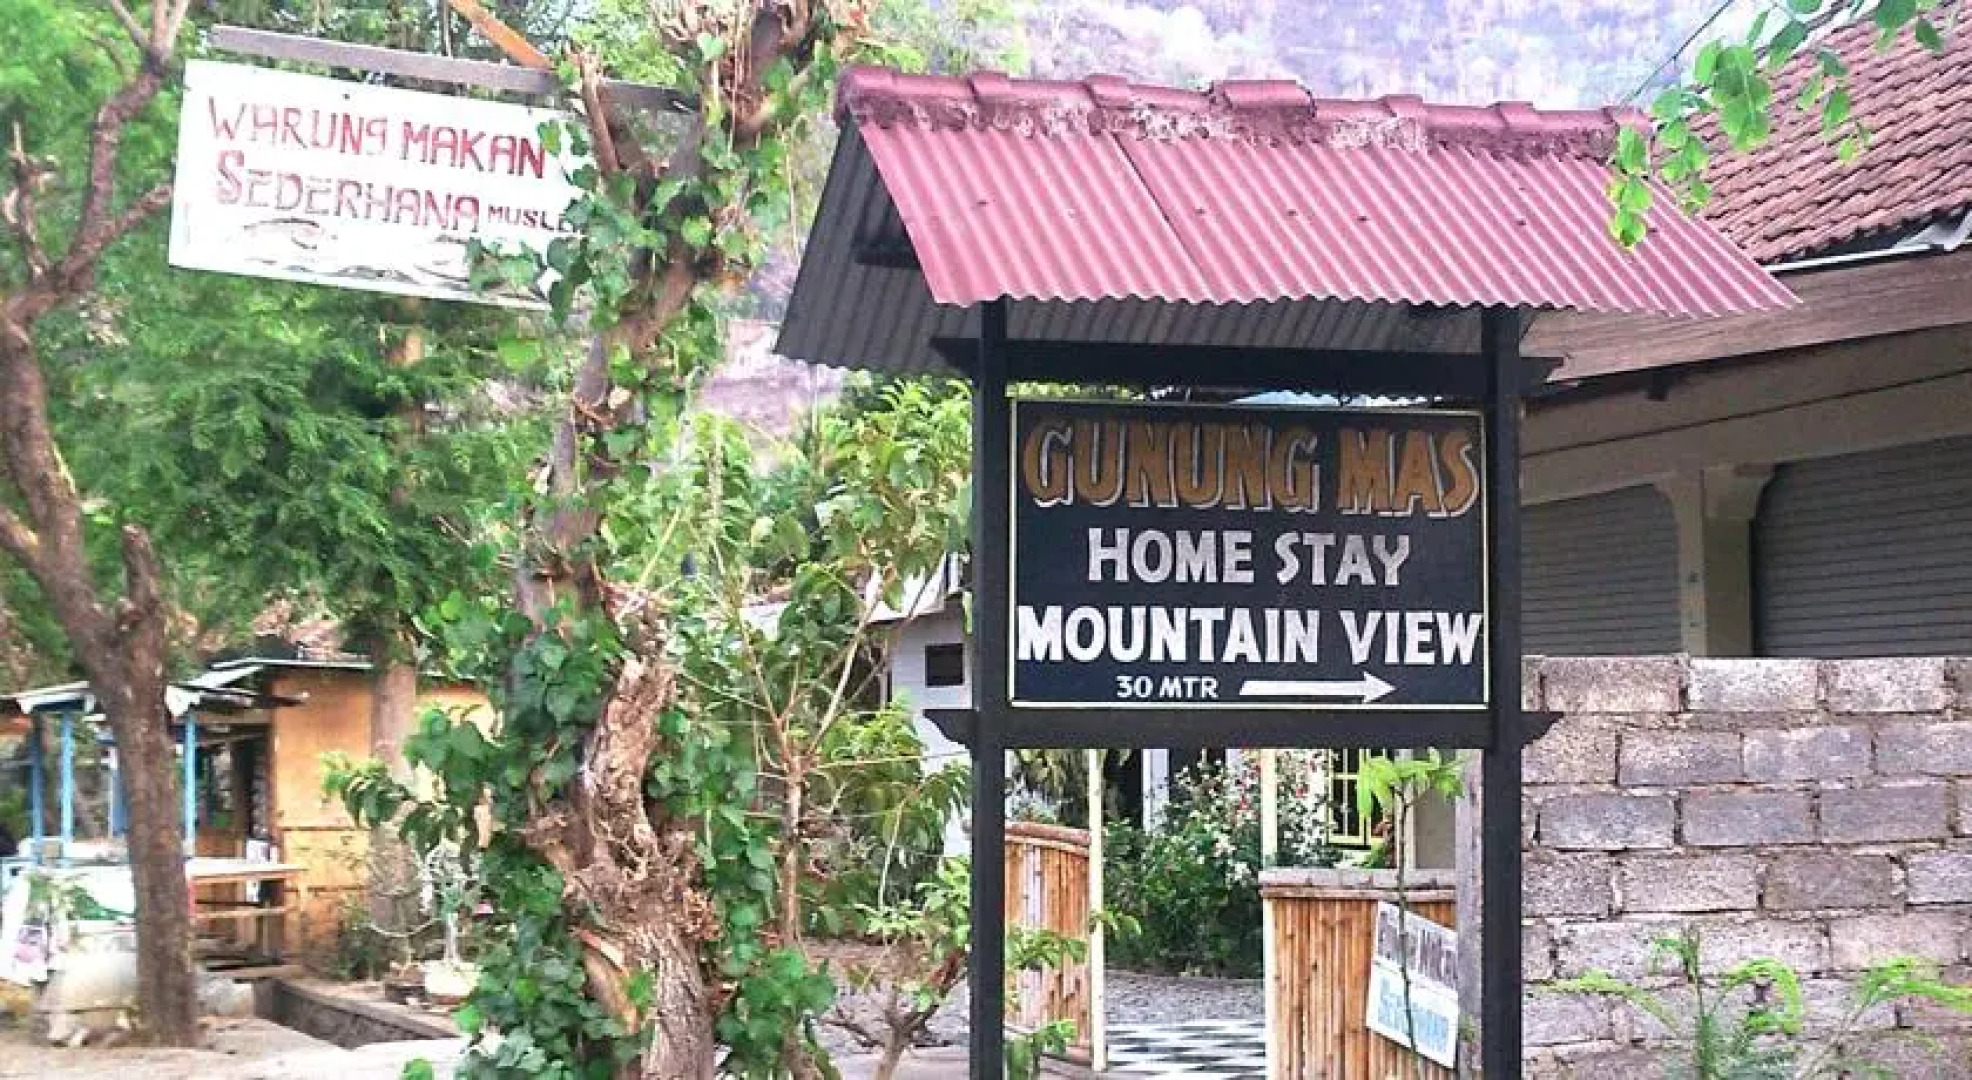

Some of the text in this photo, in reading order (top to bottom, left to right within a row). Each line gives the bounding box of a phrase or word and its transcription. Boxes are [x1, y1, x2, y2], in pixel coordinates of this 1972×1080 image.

[400, 121, 546, 180] MAKAN
[216, 150, 480, 233] SEDERHANA
[1023, 418, 1480, 518] GUNUNG MAS
[1088, 528, 1410, 586] HOME STAY
[1017, 606, 1483, 665] MOUNTAIN VIEW
[1116, 676, 1218, 699] 30 MTR
